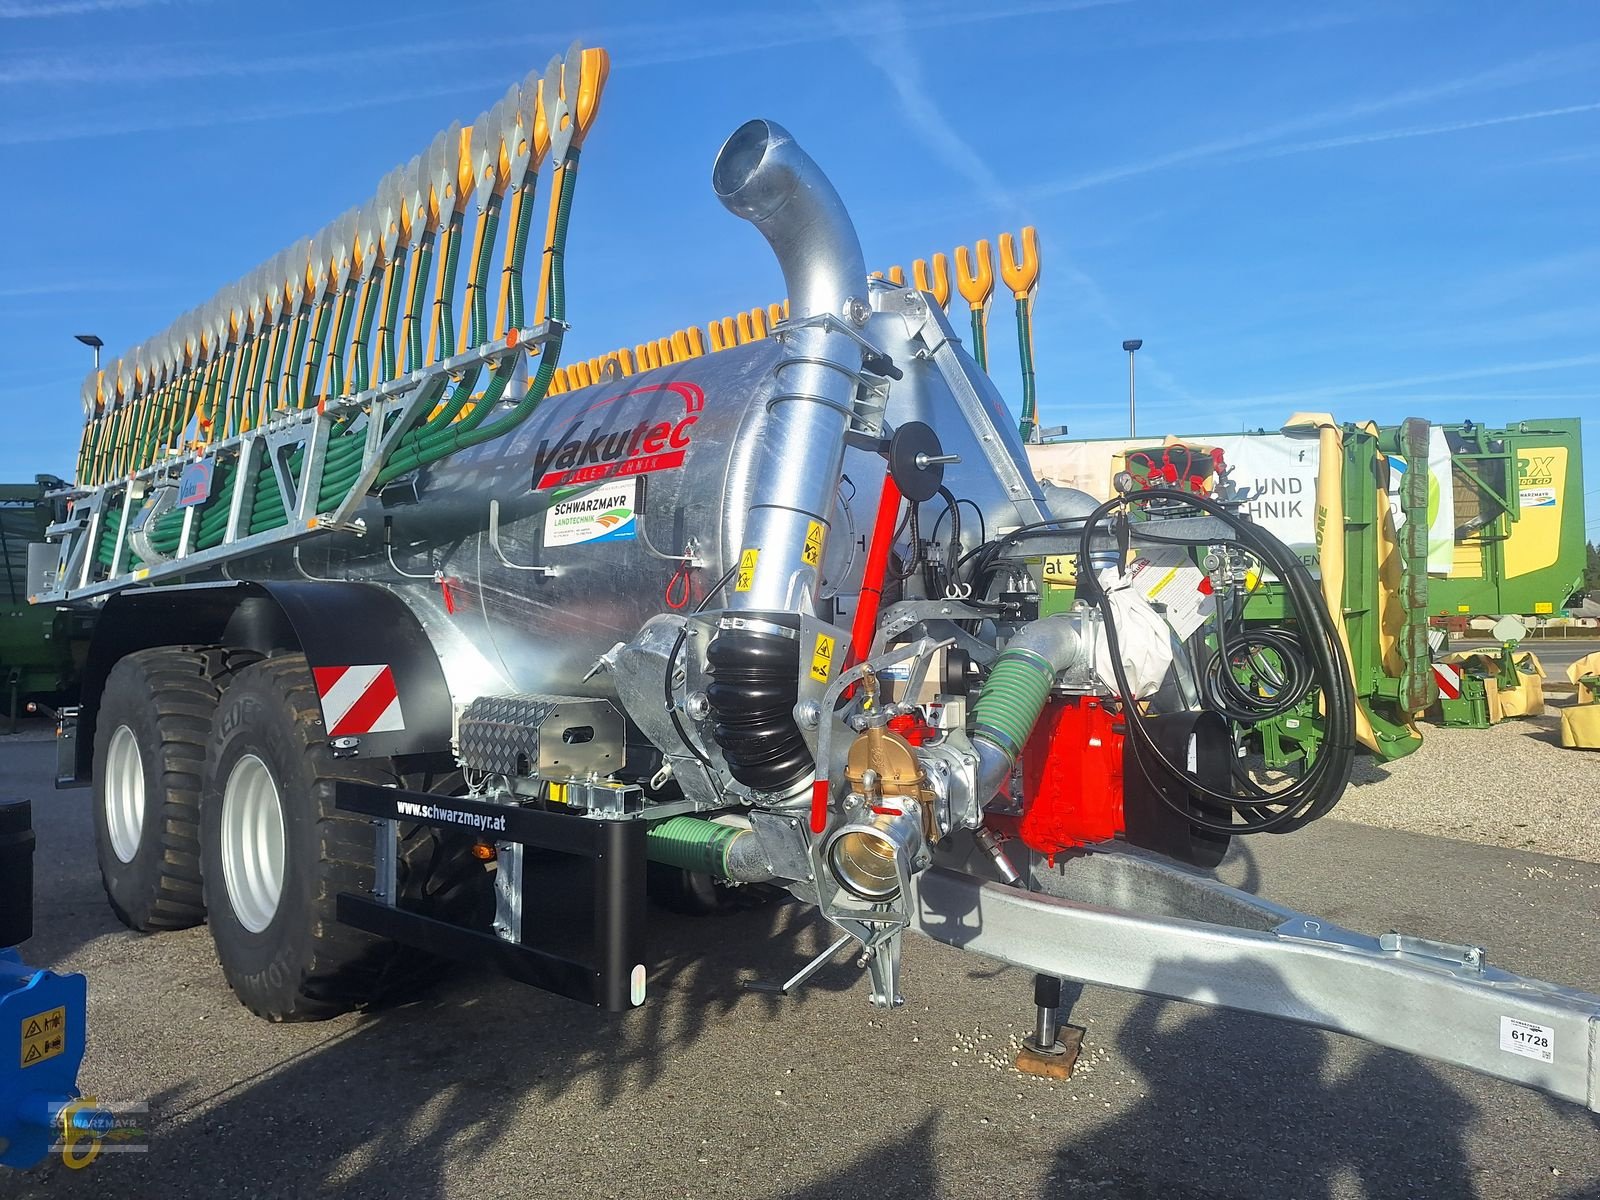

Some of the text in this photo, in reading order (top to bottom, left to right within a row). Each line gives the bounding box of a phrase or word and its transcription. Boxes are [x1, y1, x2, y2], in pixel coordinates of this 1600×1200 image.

[531, 415, 699, 491] Vakutec
[1255, 477, 1303, 495] UND
[554, 495, 627, 516] SCHWARZMAYR
[554, 515, 595, 527] LANDTECHNIK
[397, 801, 506, 832] www.schwarzmayr.at
[1511, 1030, 1548, 1048] 61728
